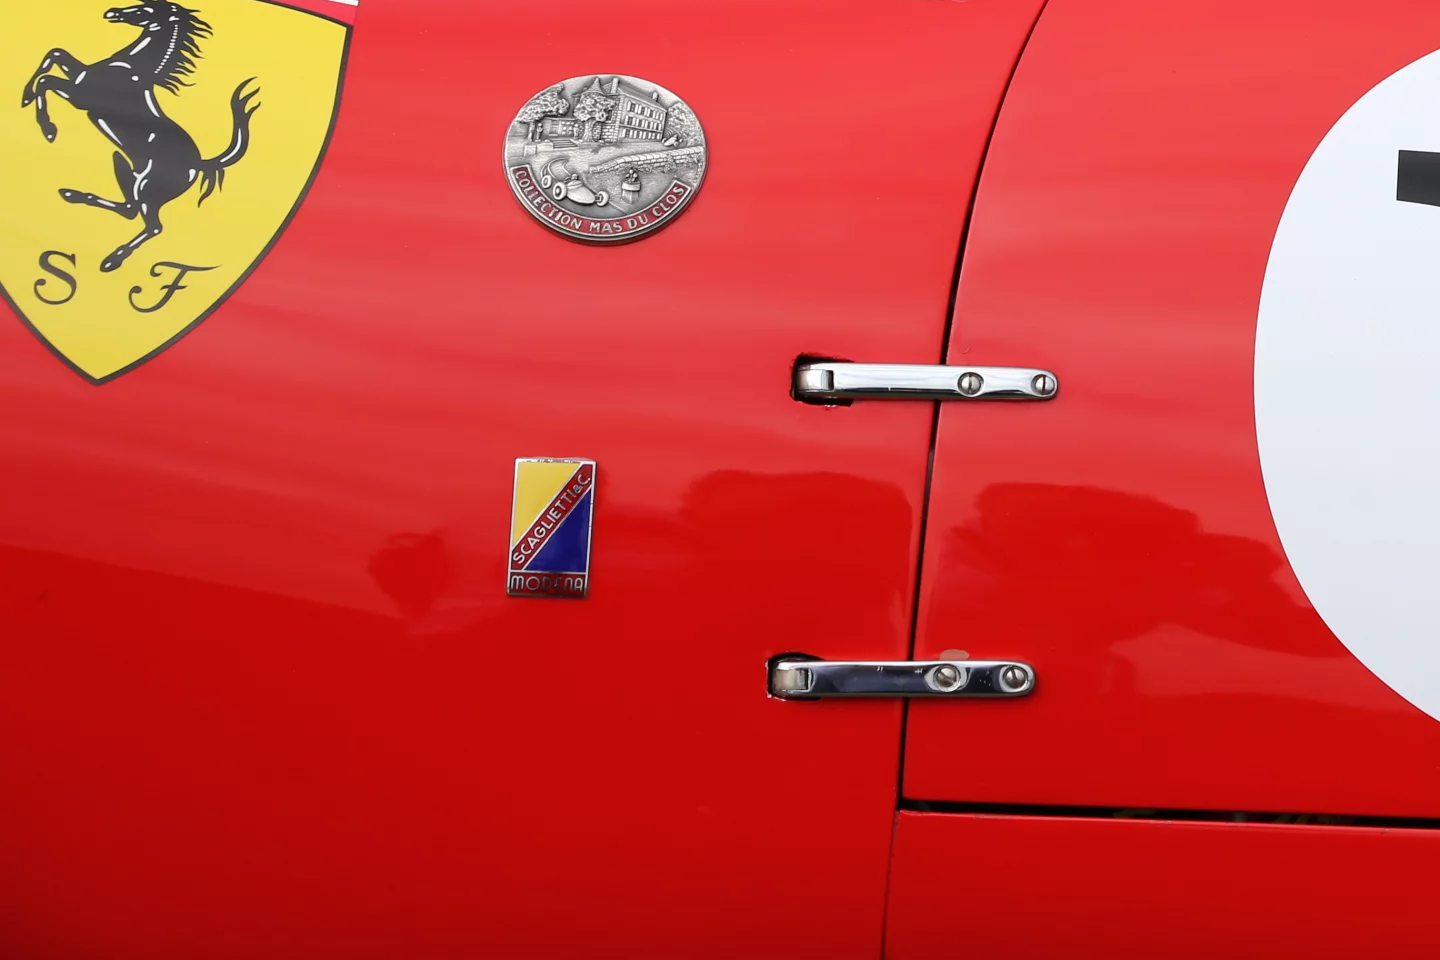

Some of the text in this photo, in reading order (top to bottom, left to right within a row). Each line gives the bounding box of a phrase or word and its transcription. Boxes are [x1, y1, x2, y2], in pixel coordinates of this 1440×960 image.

[515, 168, 686, 235] COLLECTION MAS DU CLOS
[33, 249, 221, 313] S F
[511, 575, 583, 593] MODENA
